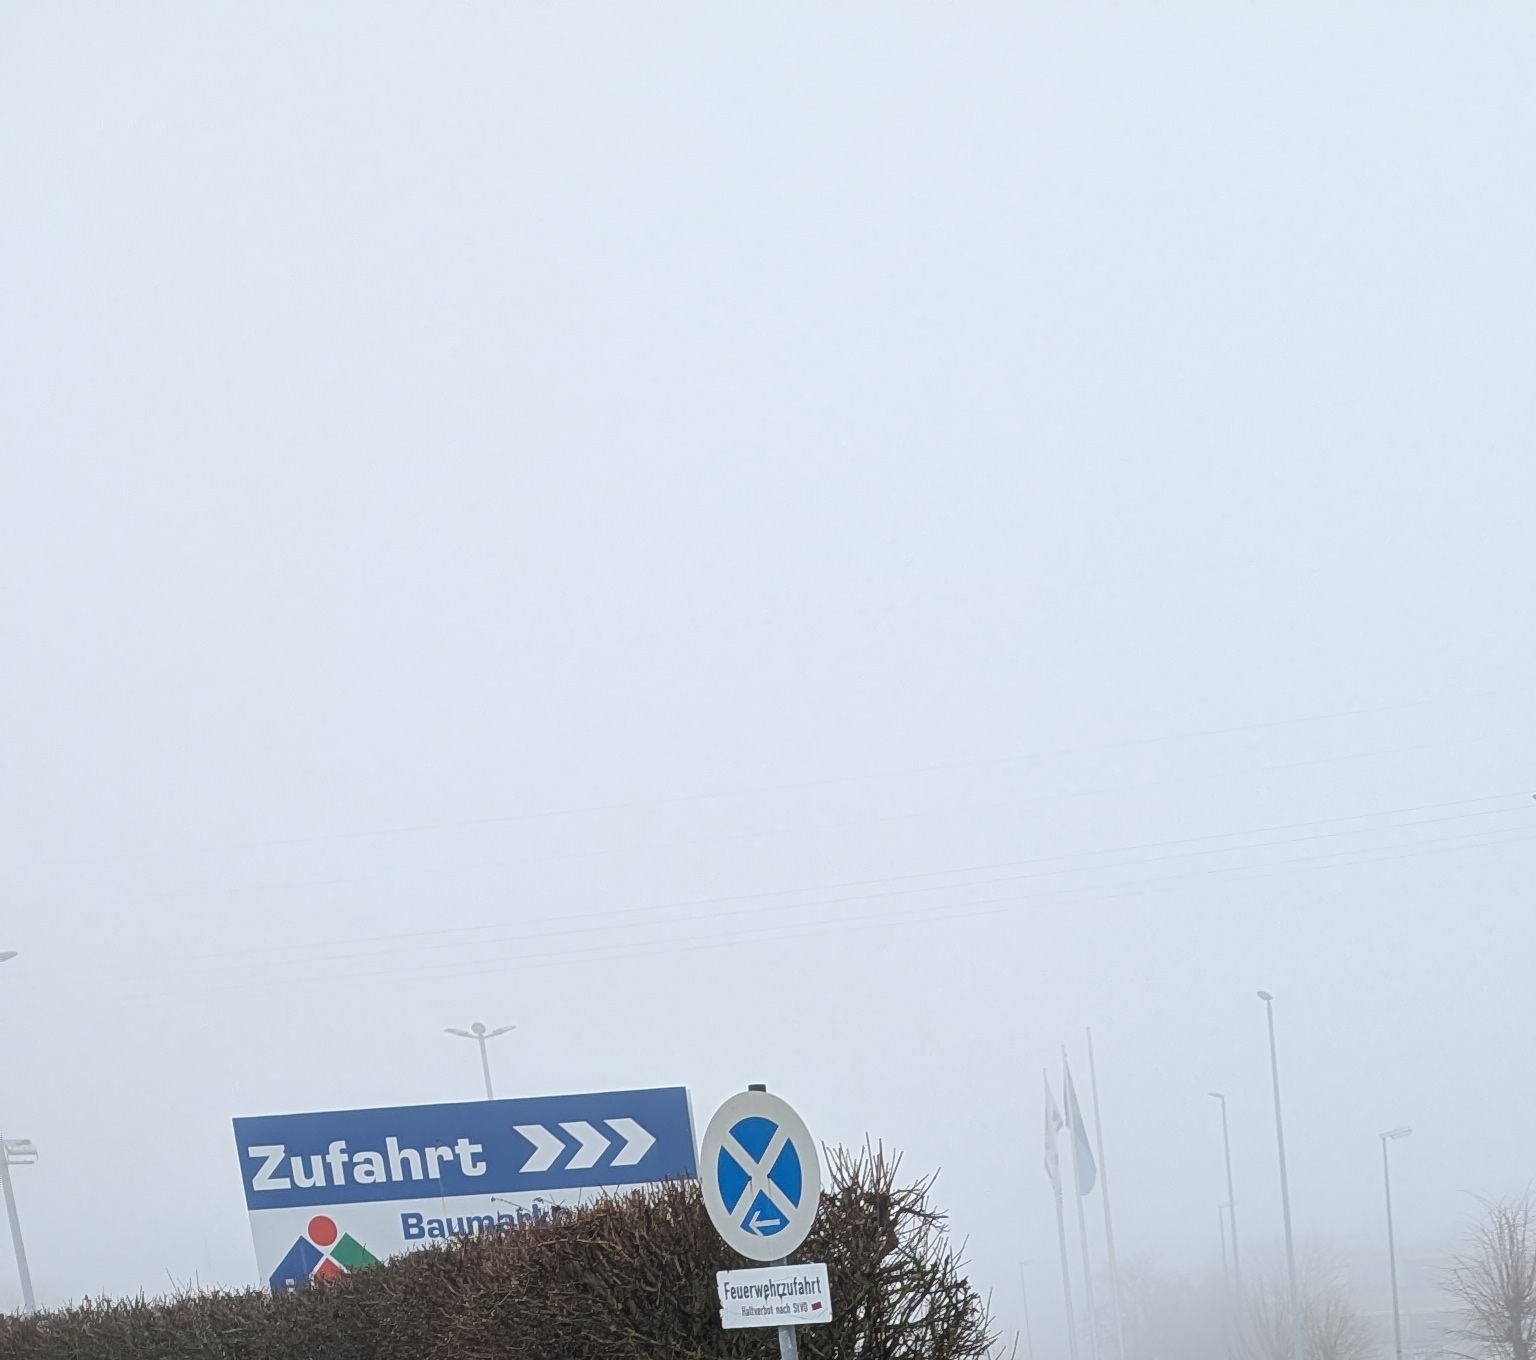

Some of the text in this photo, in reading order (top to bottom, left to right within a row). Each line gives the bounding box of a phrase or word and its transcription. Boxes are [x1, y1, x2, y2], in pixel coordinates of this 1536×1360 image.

[247, 1136, 487, 1192] Zufahrt
[400, 1203, 560, 1241] Baumark
[723, 1276, 822, 1300] Feuerwehrzufahrt
[775, 1303, 791, 1315] nach
